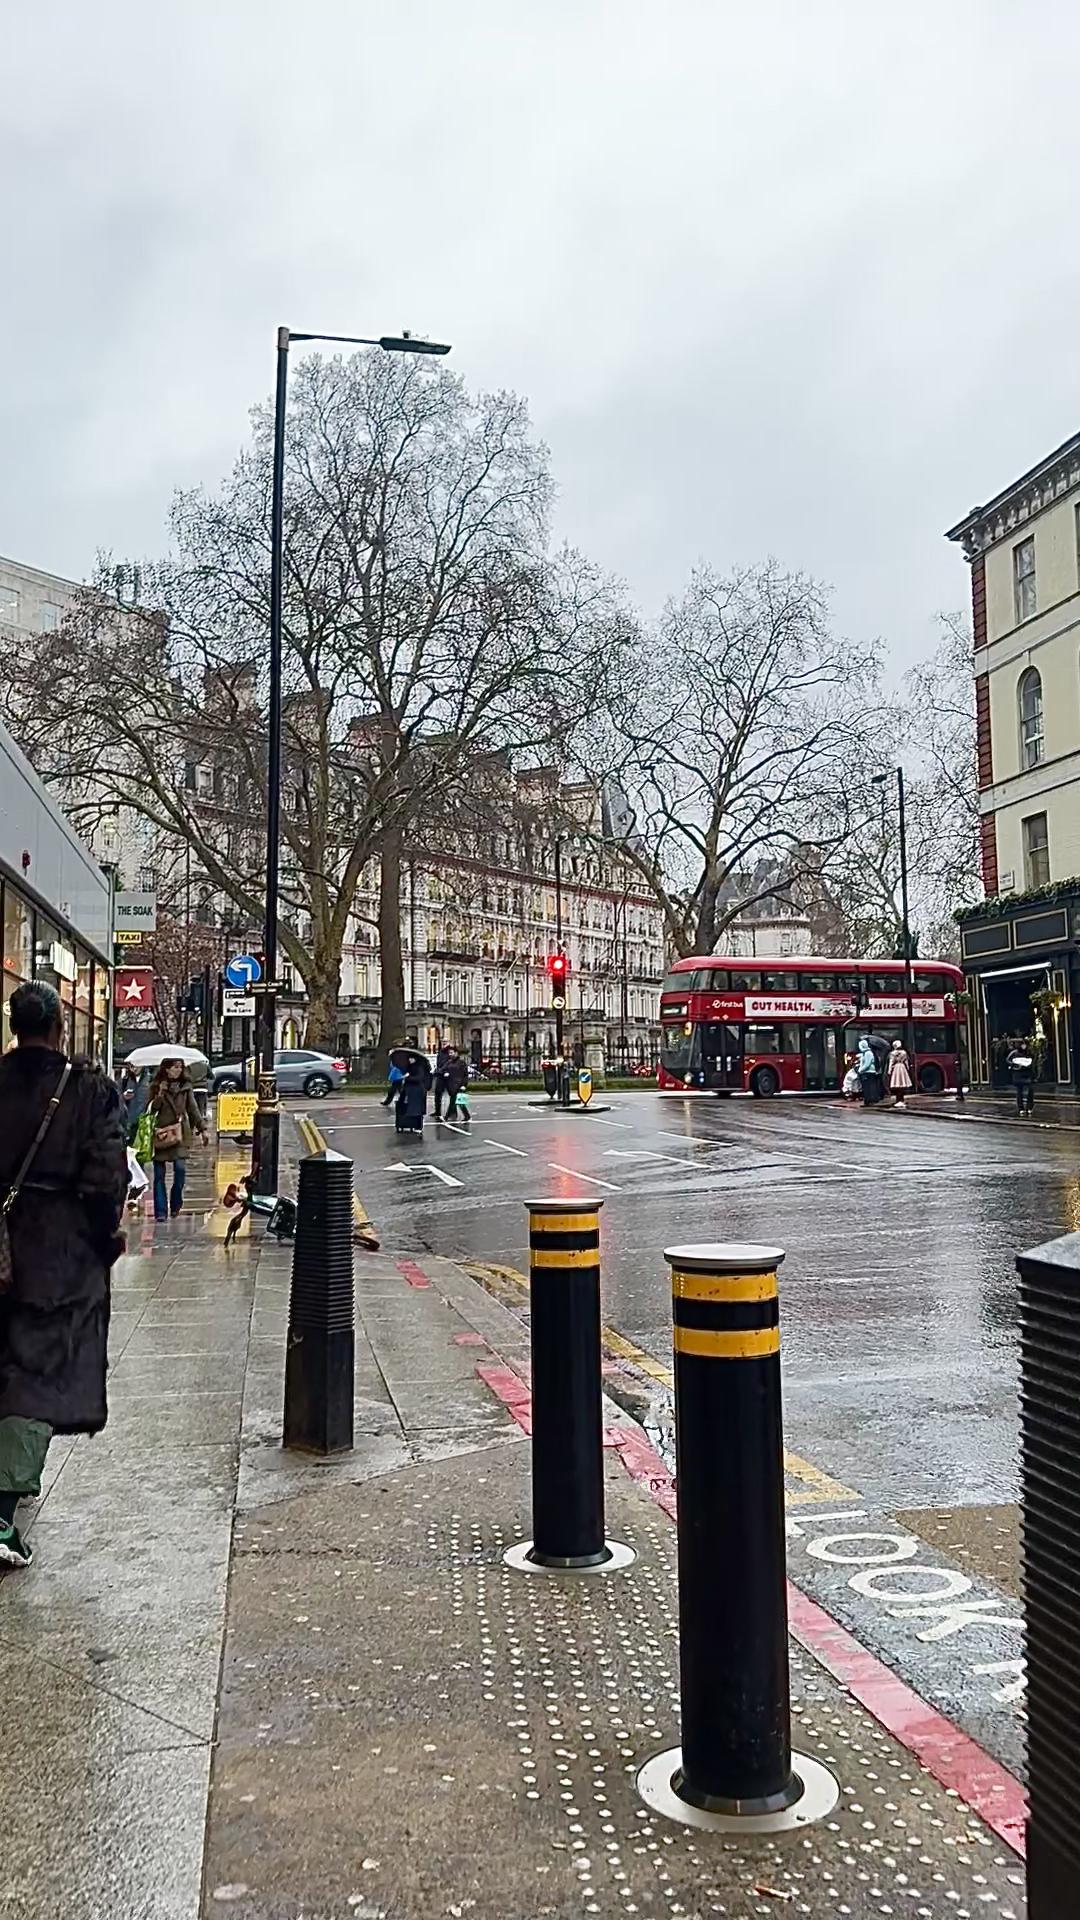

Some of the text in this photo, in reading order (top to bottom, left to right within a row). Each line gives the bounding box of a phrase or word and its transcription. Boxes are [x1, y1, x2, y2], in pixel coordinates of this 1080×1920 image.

[117, 906, 153, 916] THE SOAK
[774, 1001, 815, 1012] HEALTH.
[785, 1510, 1027, 1642] LOOK
